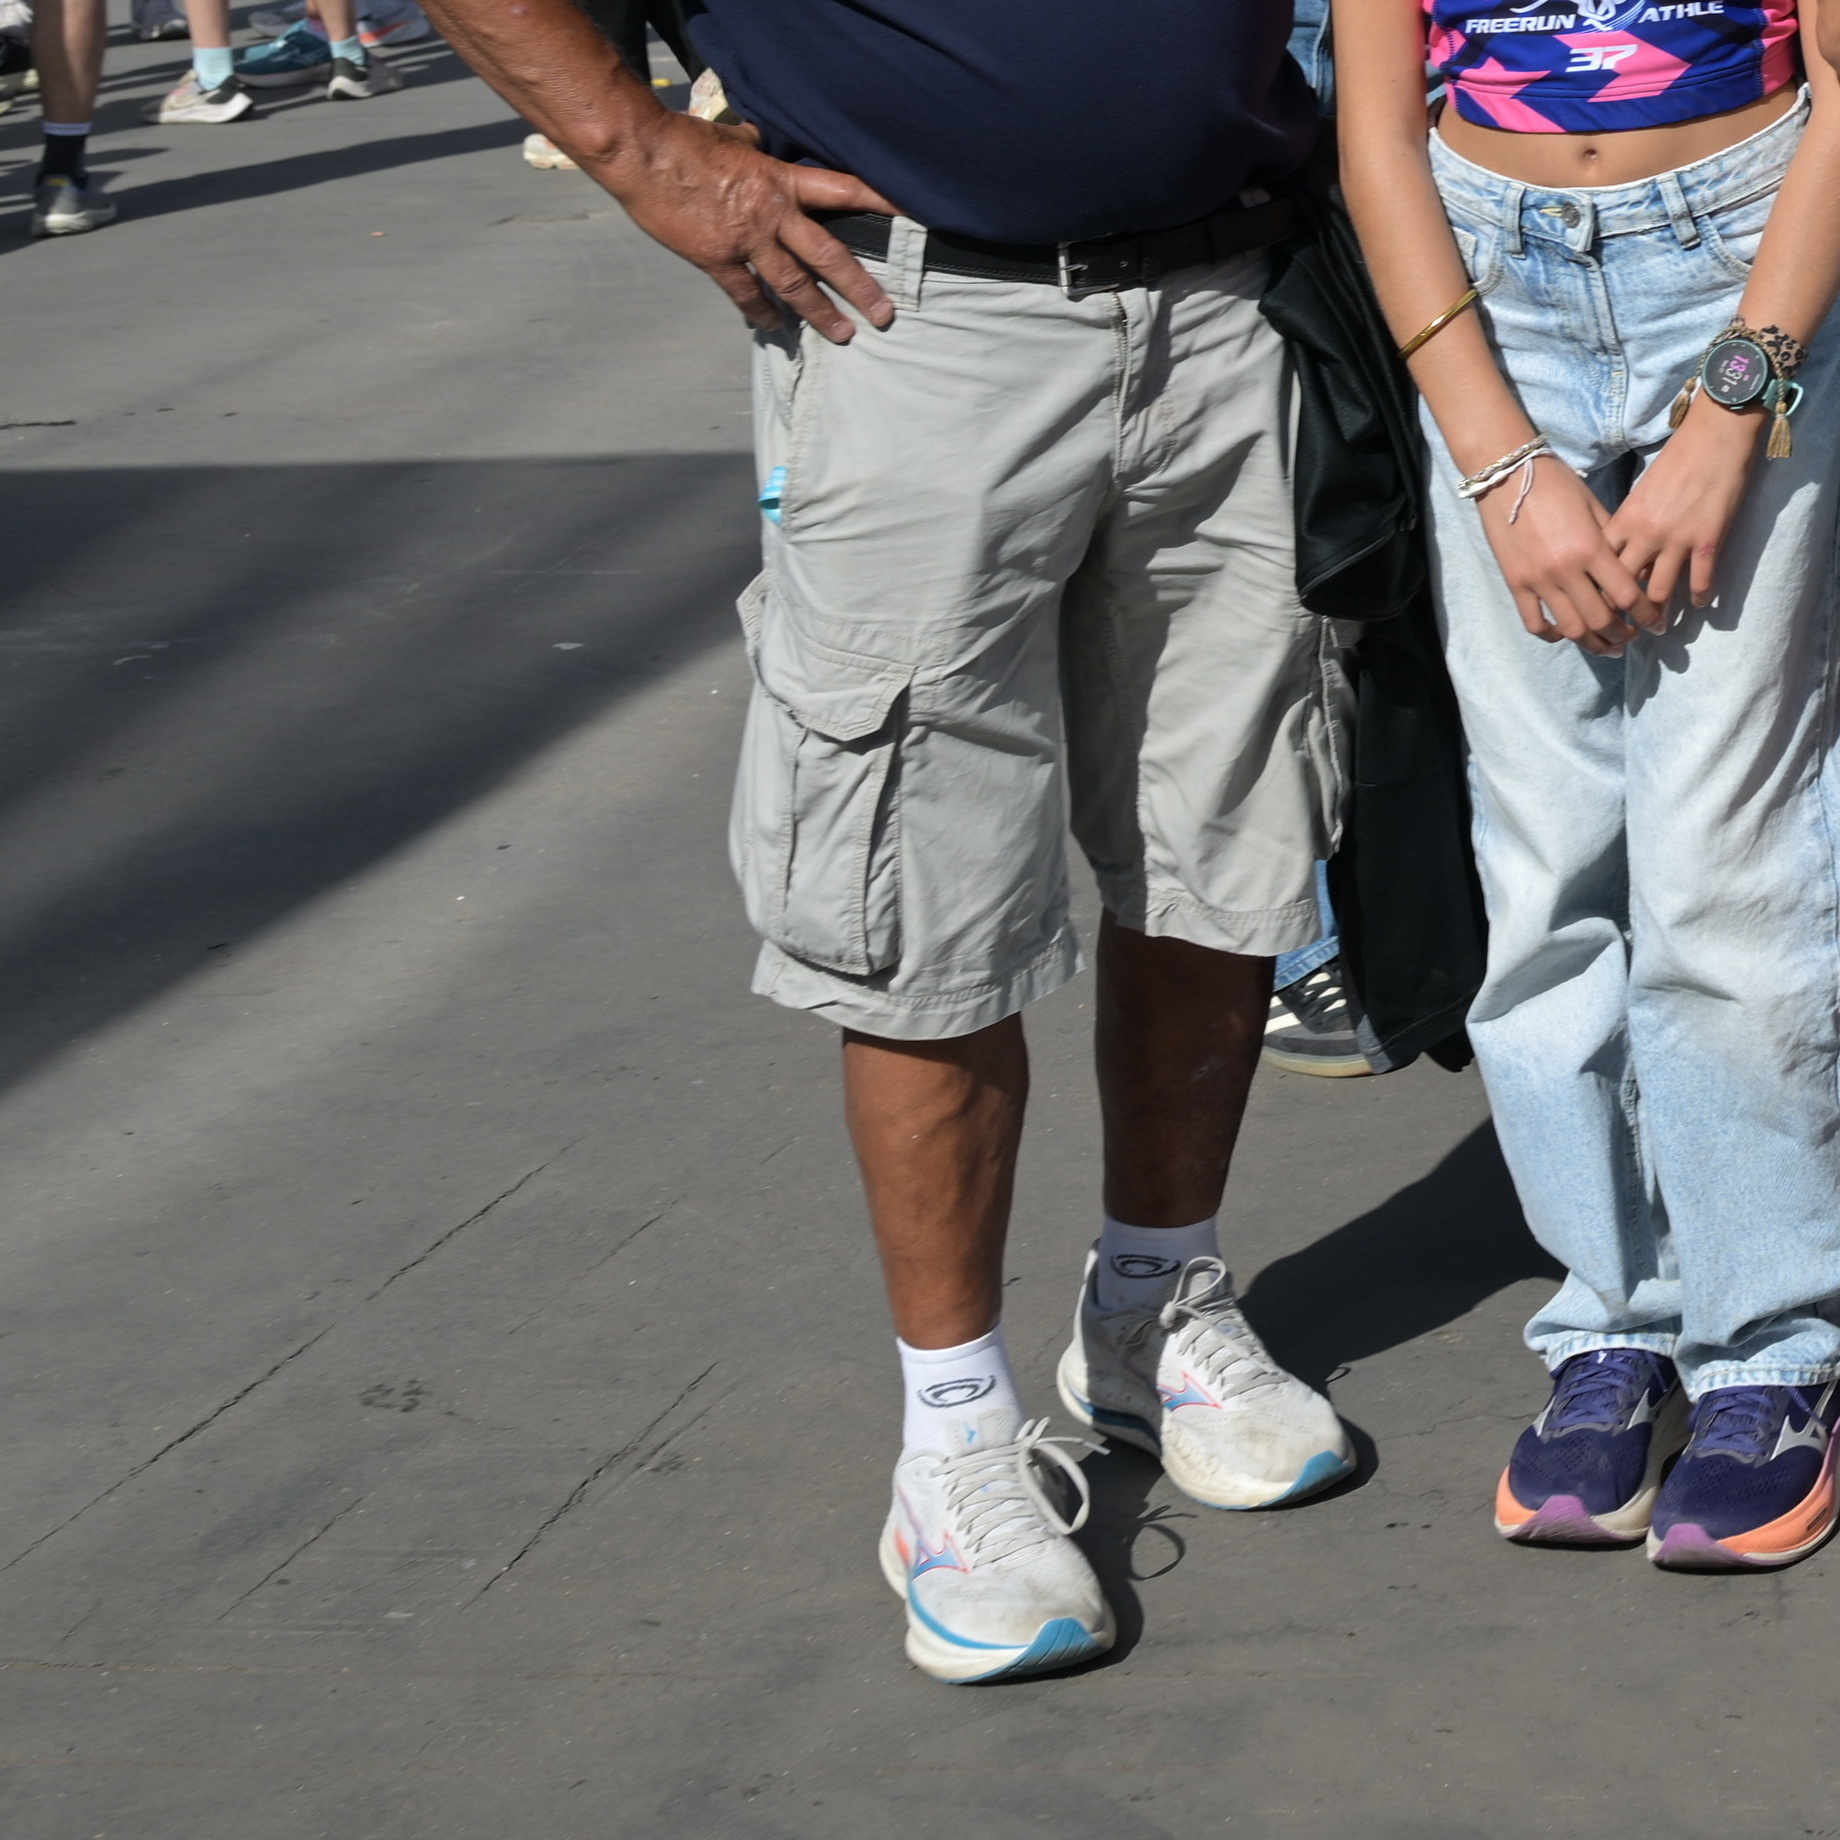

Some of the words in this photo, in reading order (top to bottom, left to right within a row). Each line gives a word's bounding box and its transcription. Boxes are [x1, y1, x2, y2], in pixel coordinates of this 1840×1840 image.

[1465, 13, 1576, 35] FREERUN
[1637, 0, 1724, 23] ATHLE
[1565, 45, 1638, 72] 37
